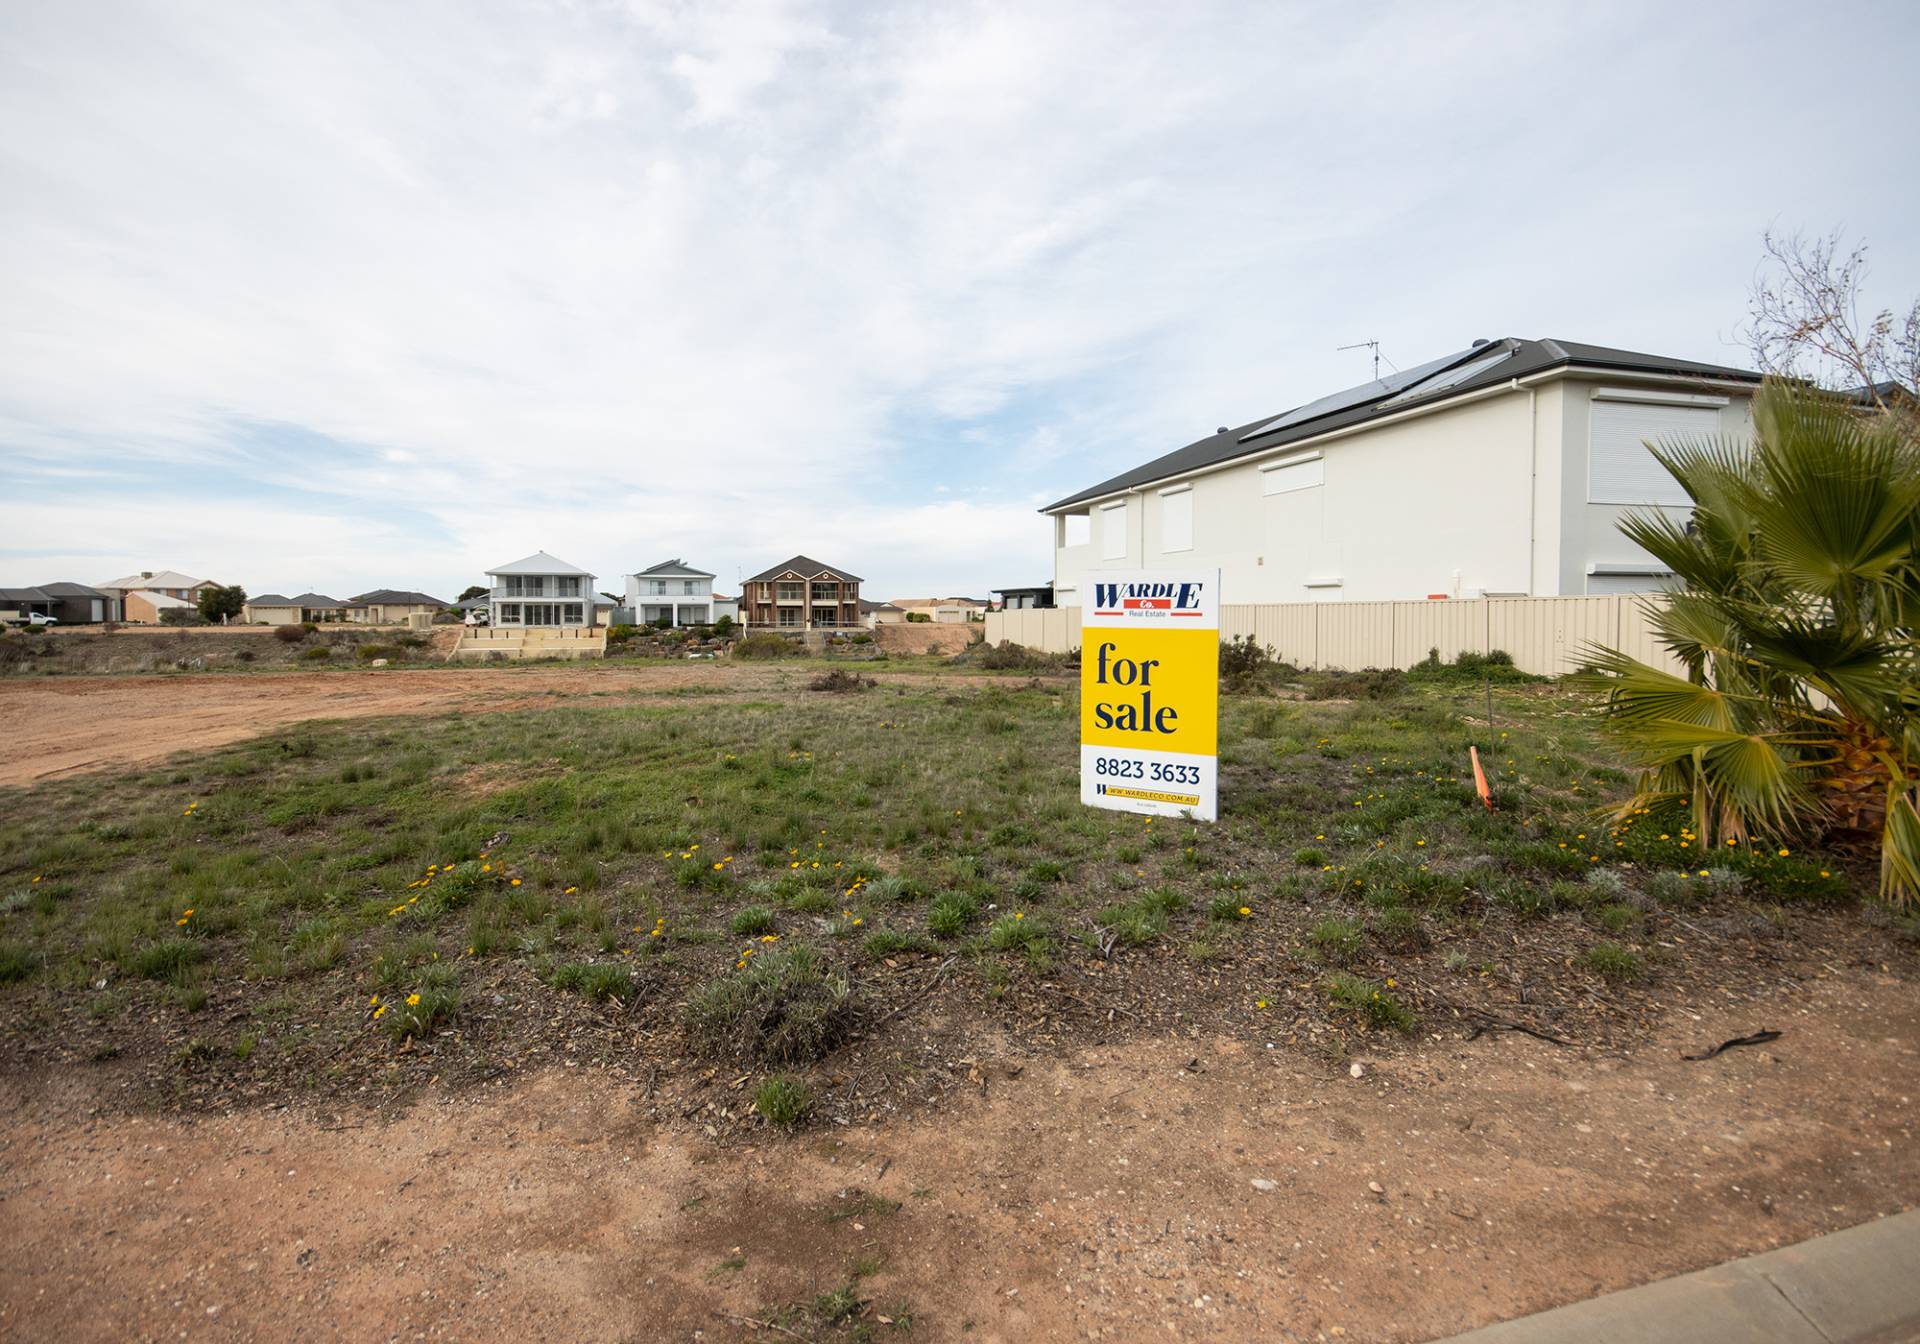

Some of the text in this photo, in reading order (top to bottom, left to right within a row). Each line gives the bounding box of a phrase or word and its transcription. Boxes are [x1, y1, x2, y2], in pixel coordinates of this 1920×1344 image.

[1095, 583, 1203, 609] WARDLE
[1139, 600, 1155, 609] Co.
[1096, 642, 1160, 687] for
[1094, 691, 1178, 734] sale
[1095, 757, 1200, 785] 8823 3633
